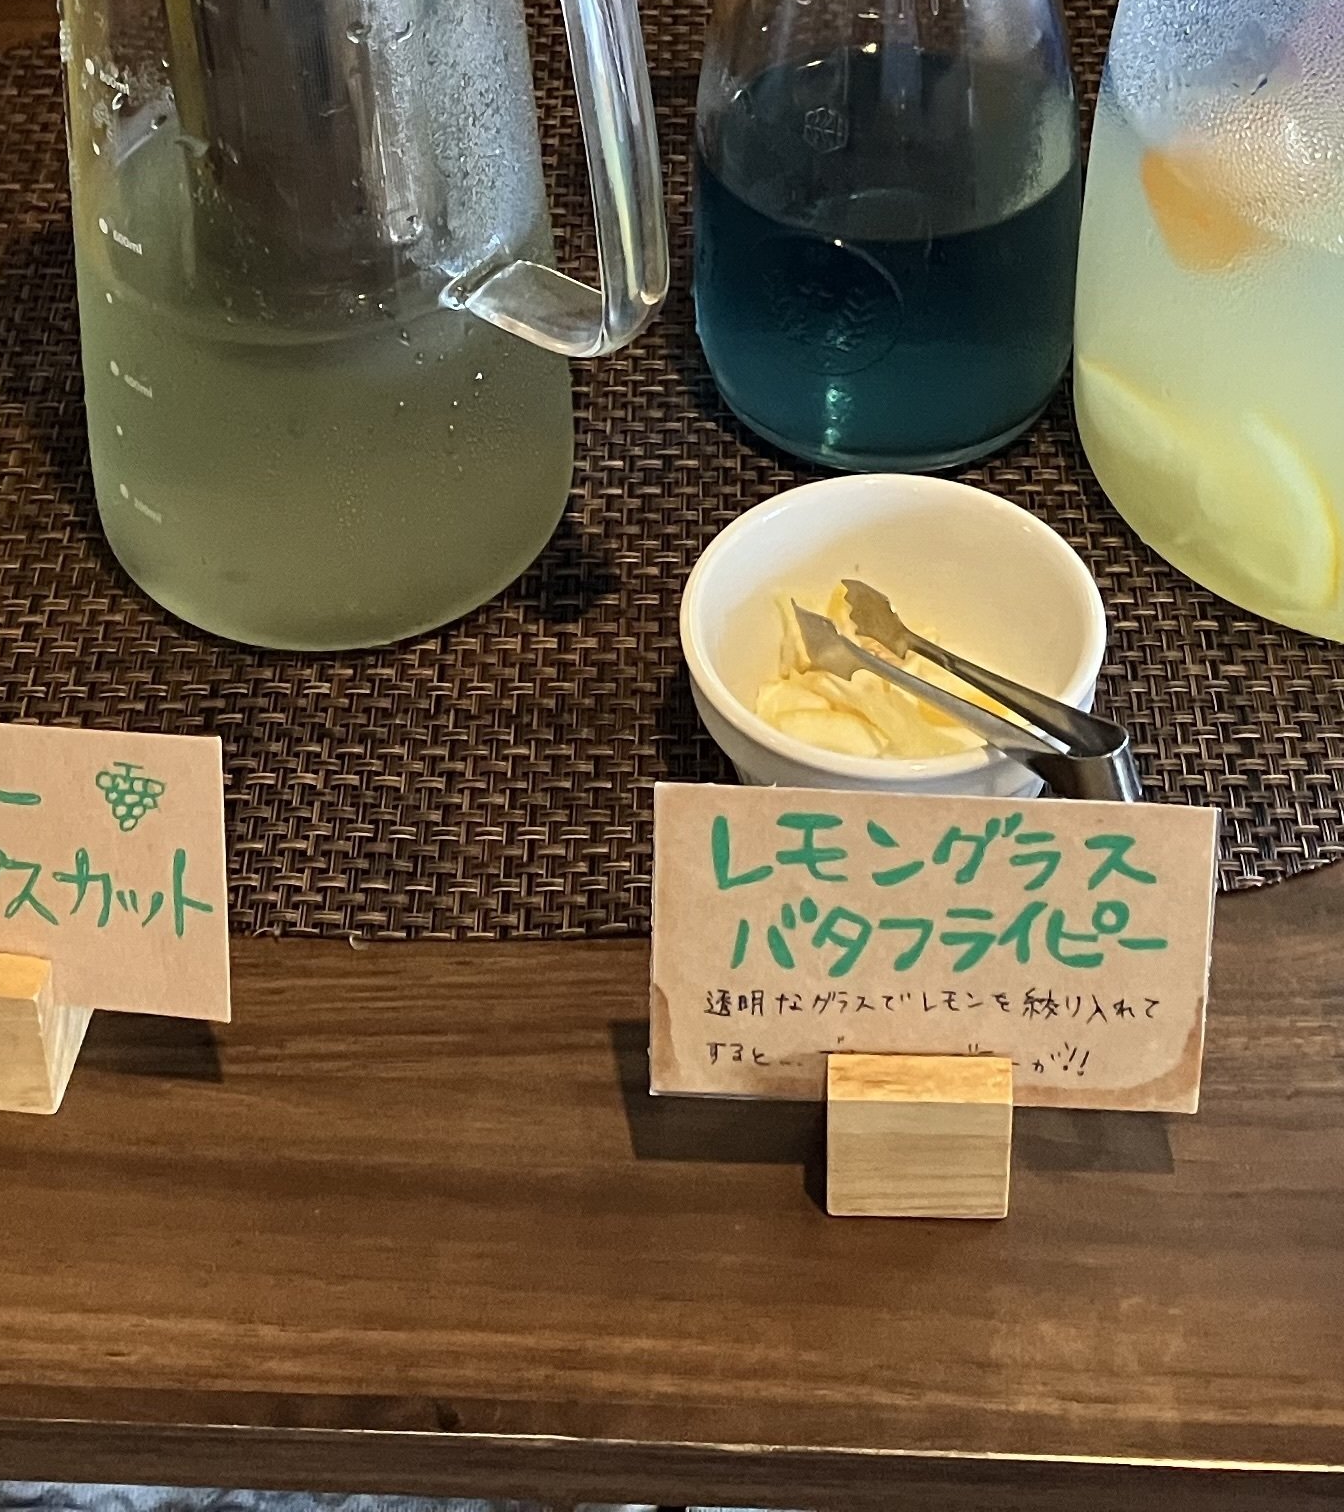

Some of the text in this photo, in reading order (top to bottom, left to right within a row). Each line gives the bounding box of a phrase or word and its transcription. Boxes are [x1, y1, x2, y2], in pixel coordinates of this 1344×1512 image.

[710, 811, 1158, 890] レモングラス
[730, 896, 1168, 978] バタフライピー
[703, 987, 1162, 1024] 透明なグラスでレモンを絞り入れて
